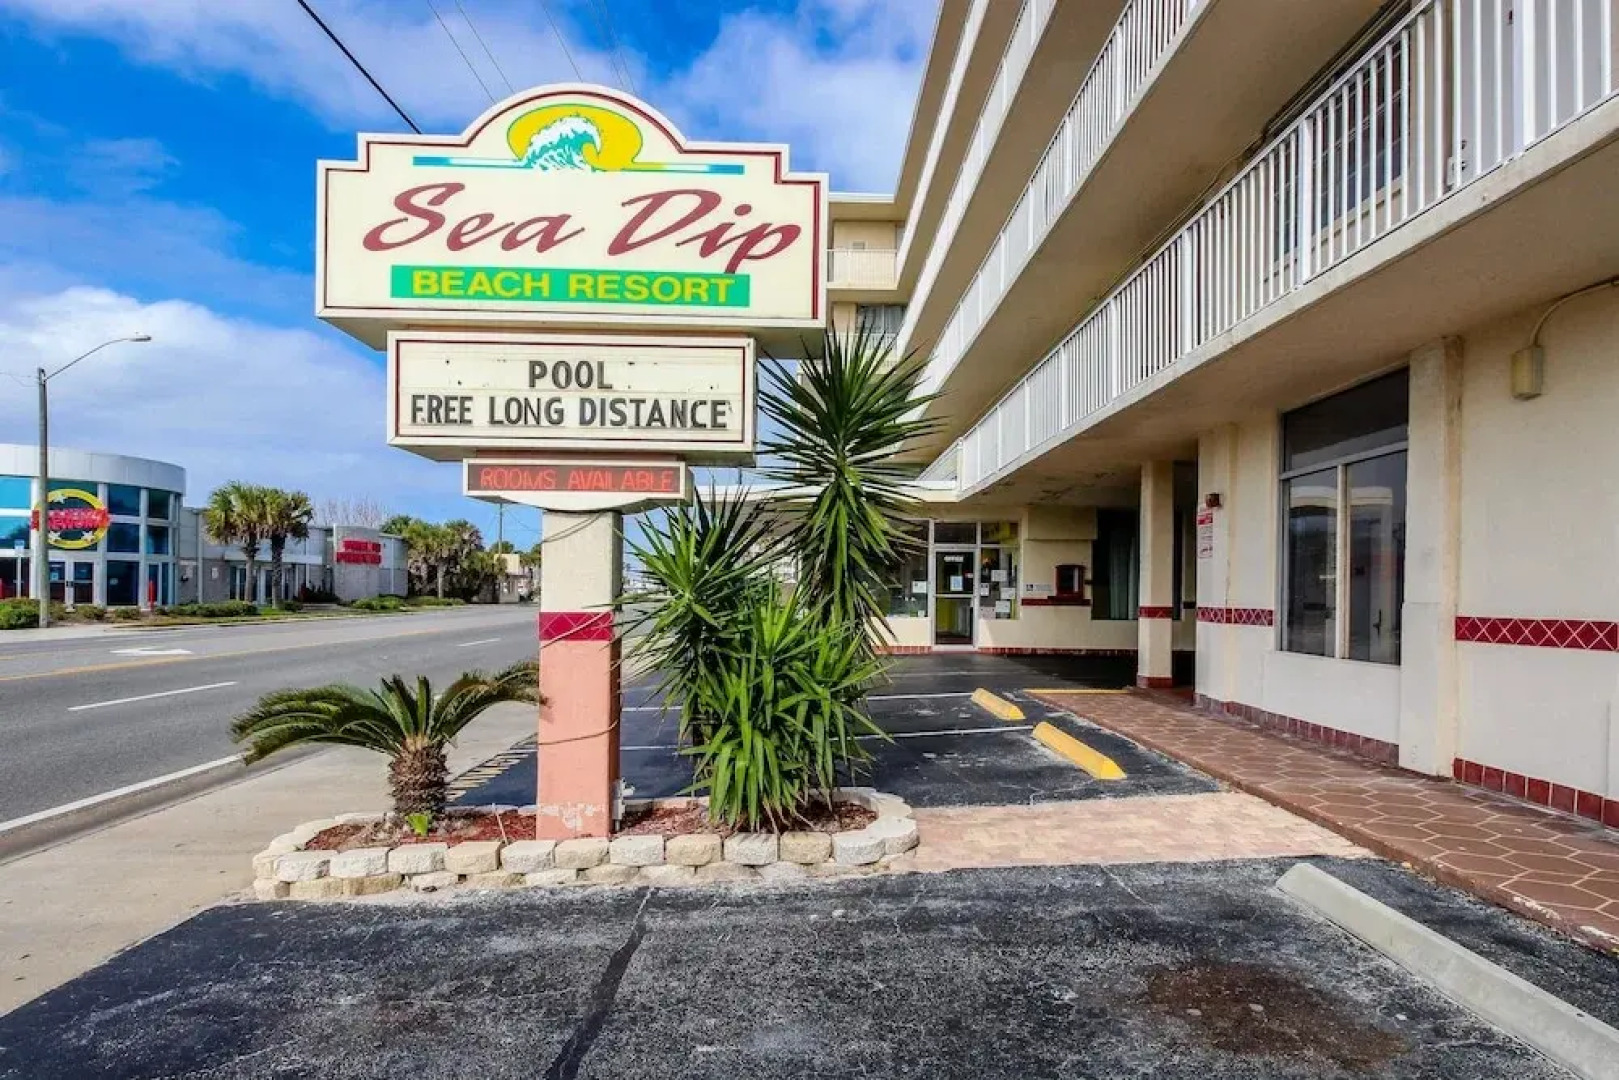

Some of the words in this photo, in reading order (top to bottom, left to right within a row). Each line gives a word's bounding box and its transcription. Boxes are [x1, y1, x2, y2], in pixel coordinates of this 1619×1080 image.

[363, 182, 585, 253] Sea
[607, 188, 802, 275] Dip
[411, 270, 550, 299] BEACH
[568, 274, 735, 304] RESORT
[528, 360, 613, 390] POOL
[411, 394, 474, 426] FREE
[488, 396, 565, 427] LONG
[579, 398, 729, 429] DISTANCE
[480, 468, 558, 491] ROOMS
[567, 470, 675, 493] AVAILABLE
